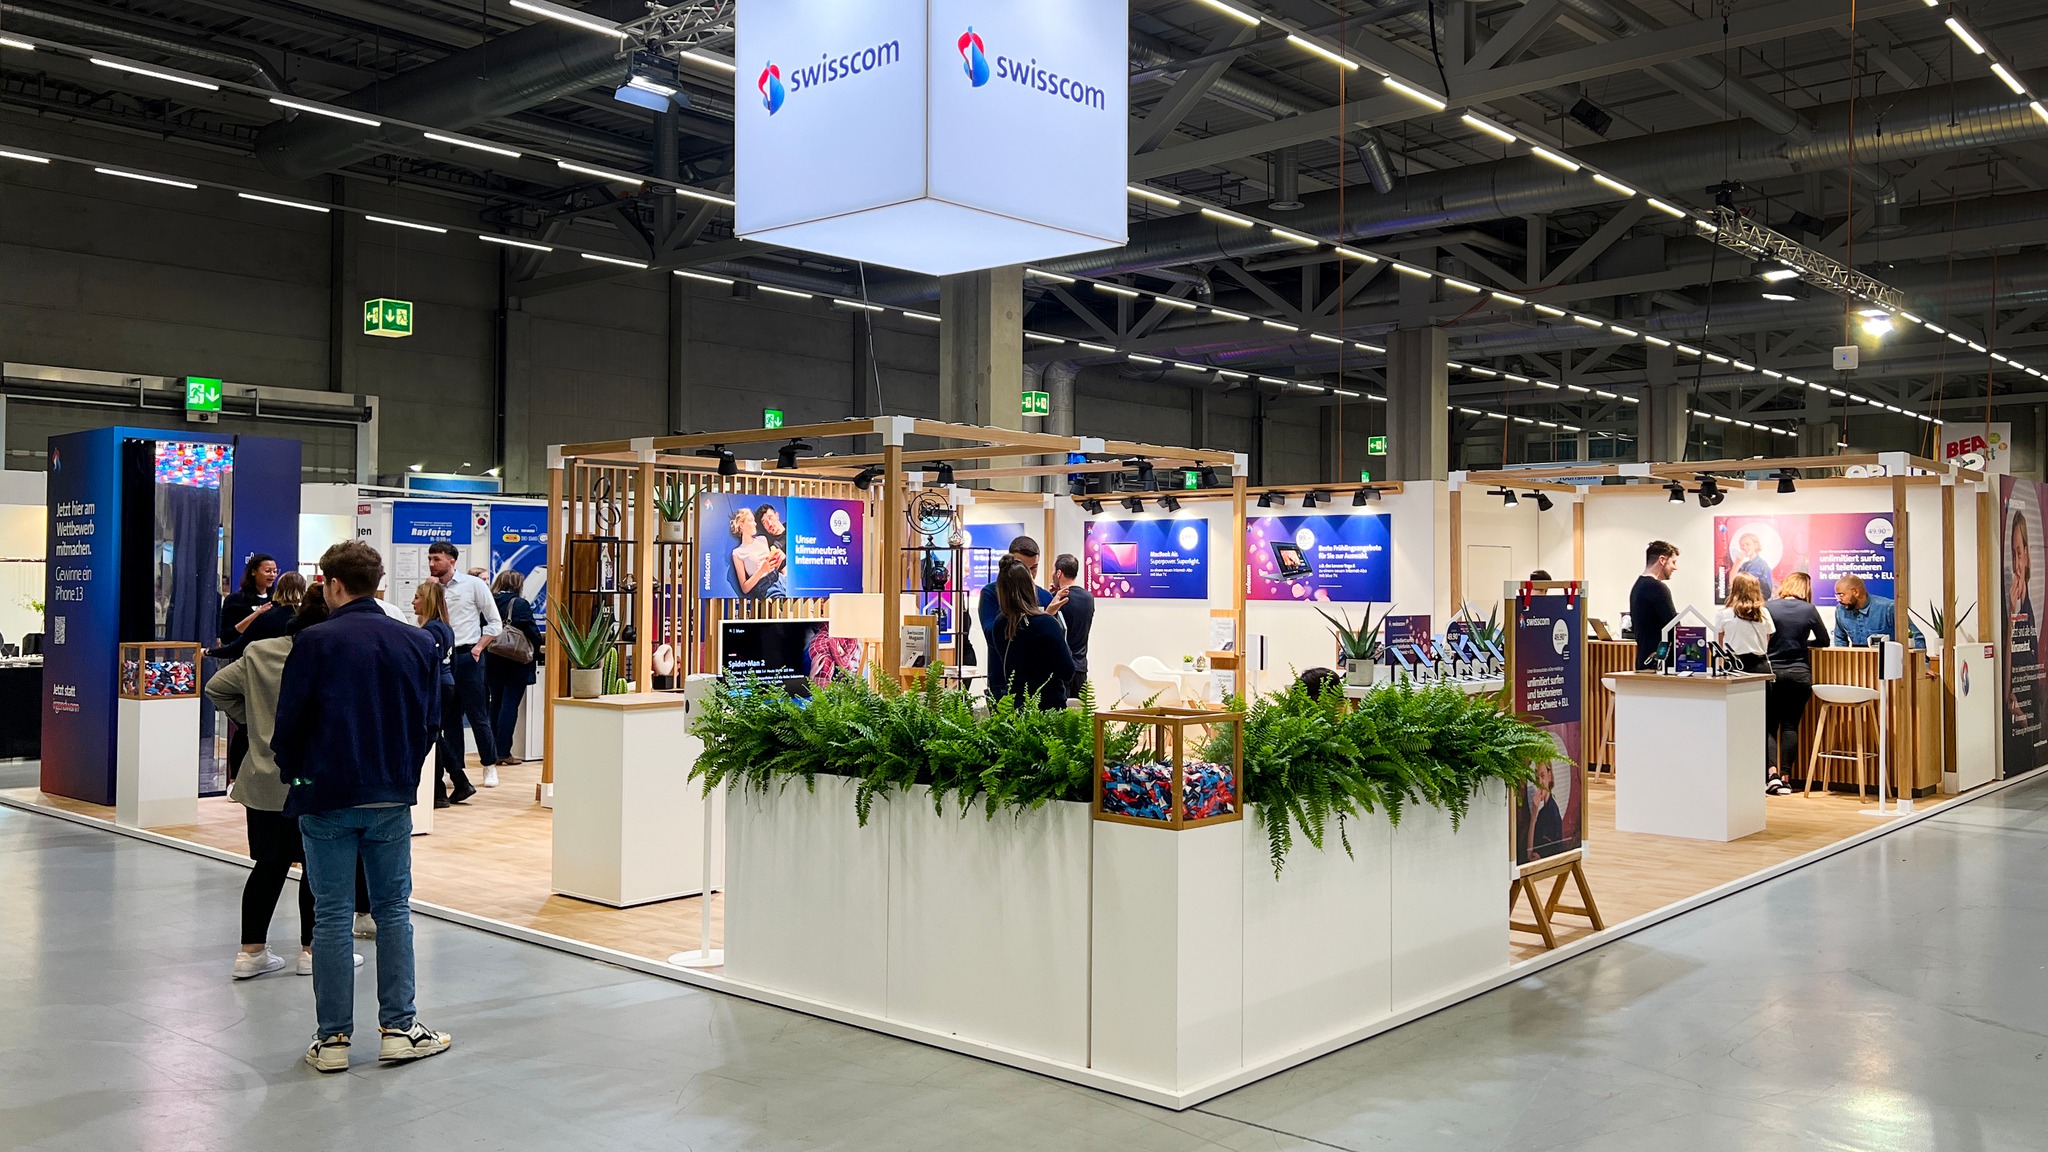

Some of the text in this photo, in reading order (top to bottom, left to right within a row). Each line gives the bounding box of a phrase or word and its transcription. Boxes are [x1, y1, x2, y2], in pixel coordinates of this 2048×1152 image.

[790, 39, 900, 94] swisscom
[996, 55, 1105, 111] swisscom
[1946, 435, 1988, 459] BEA
[56, 500, 95, 517] Jetzt hier am
[56, 519, 95, 537] Wettbewerb
[411, 527, 452, 537] Rayforce
[795, 534, 817, 544] Unser
[55, 540, 92, 556] mitmachen.
[795, 544, 847, 555] klimaneutrales
[795, 555, 849, 565] Internet mit TV.
[1819, 554, 1886, 563] unlimitiert surfen
[55, 565, 92, 581] Gewinne ein
[1819, 563, 1882, 571] und telefonieren
[1819, 572, 1828, 580] in
[1828, 572, 1841, 580] der
[1881, 572, 1894, 580] EU.
[55, 586, 84, 601] iPhone 13
[1526, 615, 1551, 627] swisscom
[728, 659, 766, 669] Spider-Man 2
[1527, 674, 1564, 688] unlimitiert surfen
[1527, 687, 1562, 700] und telefonieren
[1527, 702, 1532, 712] in
[1532, 701, 1540, 711] der
[1540, 699, 1558, 710] Schweiz
